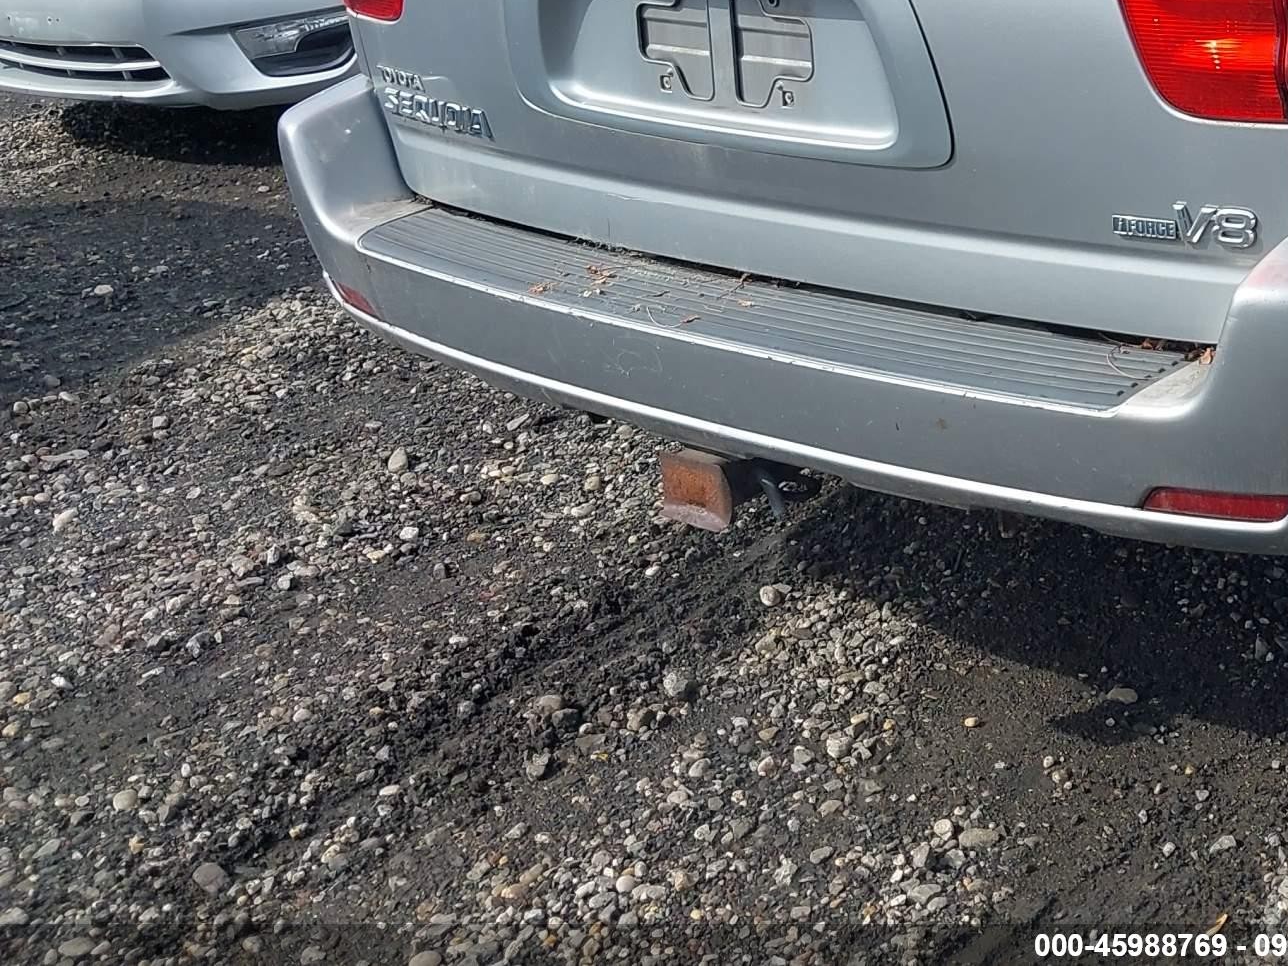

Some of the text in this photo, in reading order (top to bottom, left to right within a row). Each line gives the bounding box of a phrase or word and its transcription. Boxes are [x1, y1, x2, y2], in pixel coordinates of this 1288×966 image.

[376, 65, 426, 92] TOYOTA
[383, 86, 496, 142] SEQUOIA
[1172, 201, 1259, 249] V8
